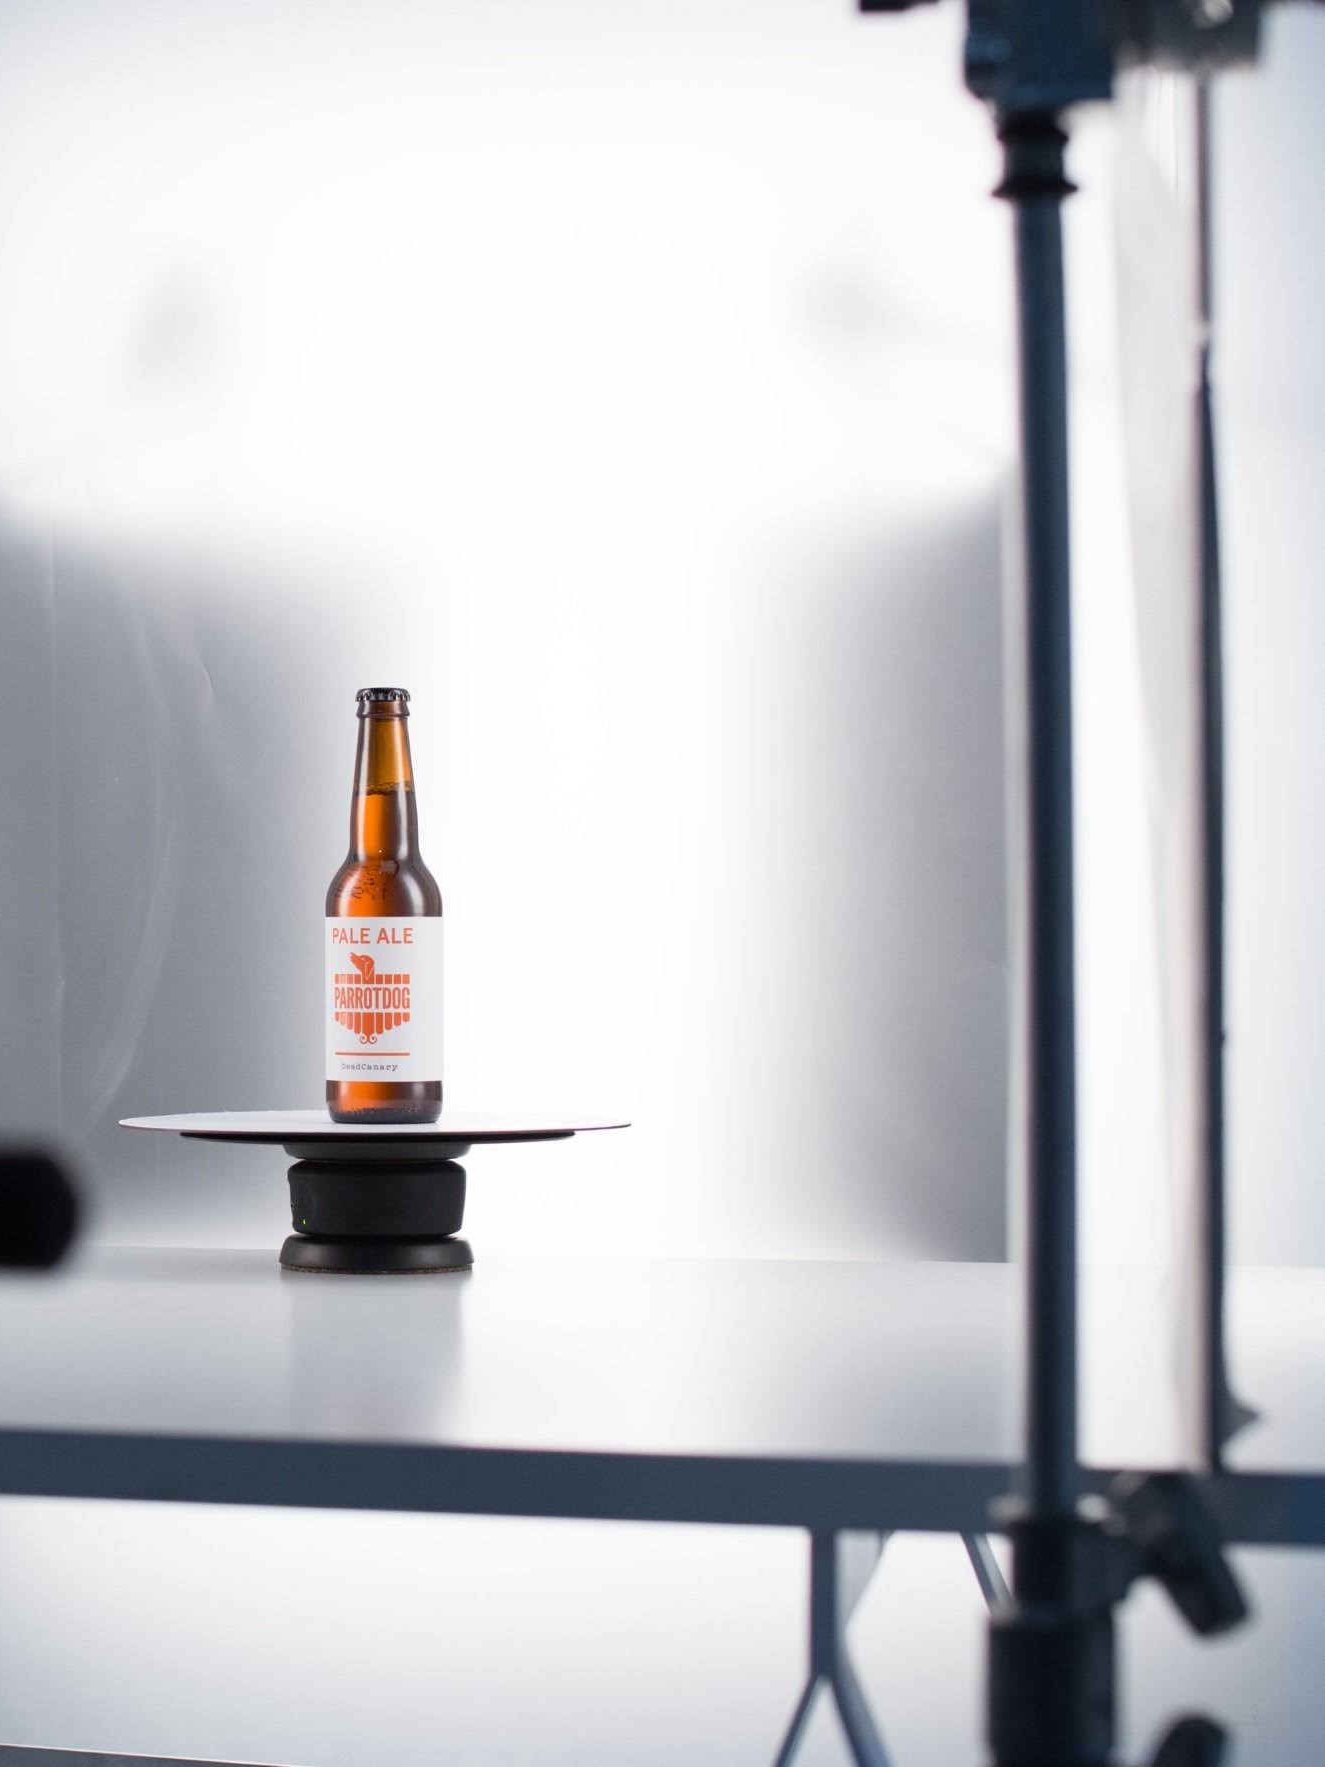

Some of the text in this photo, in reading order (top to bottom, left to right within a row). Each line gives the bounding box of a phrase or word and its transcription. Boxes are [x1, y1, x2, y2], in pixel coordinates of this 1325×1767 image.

[332, 927, 414, 944] PALE ALE
[334, 986, 411, 1010] PARROTDOG
[341, 1063, 398, 1072] DeadCanary
